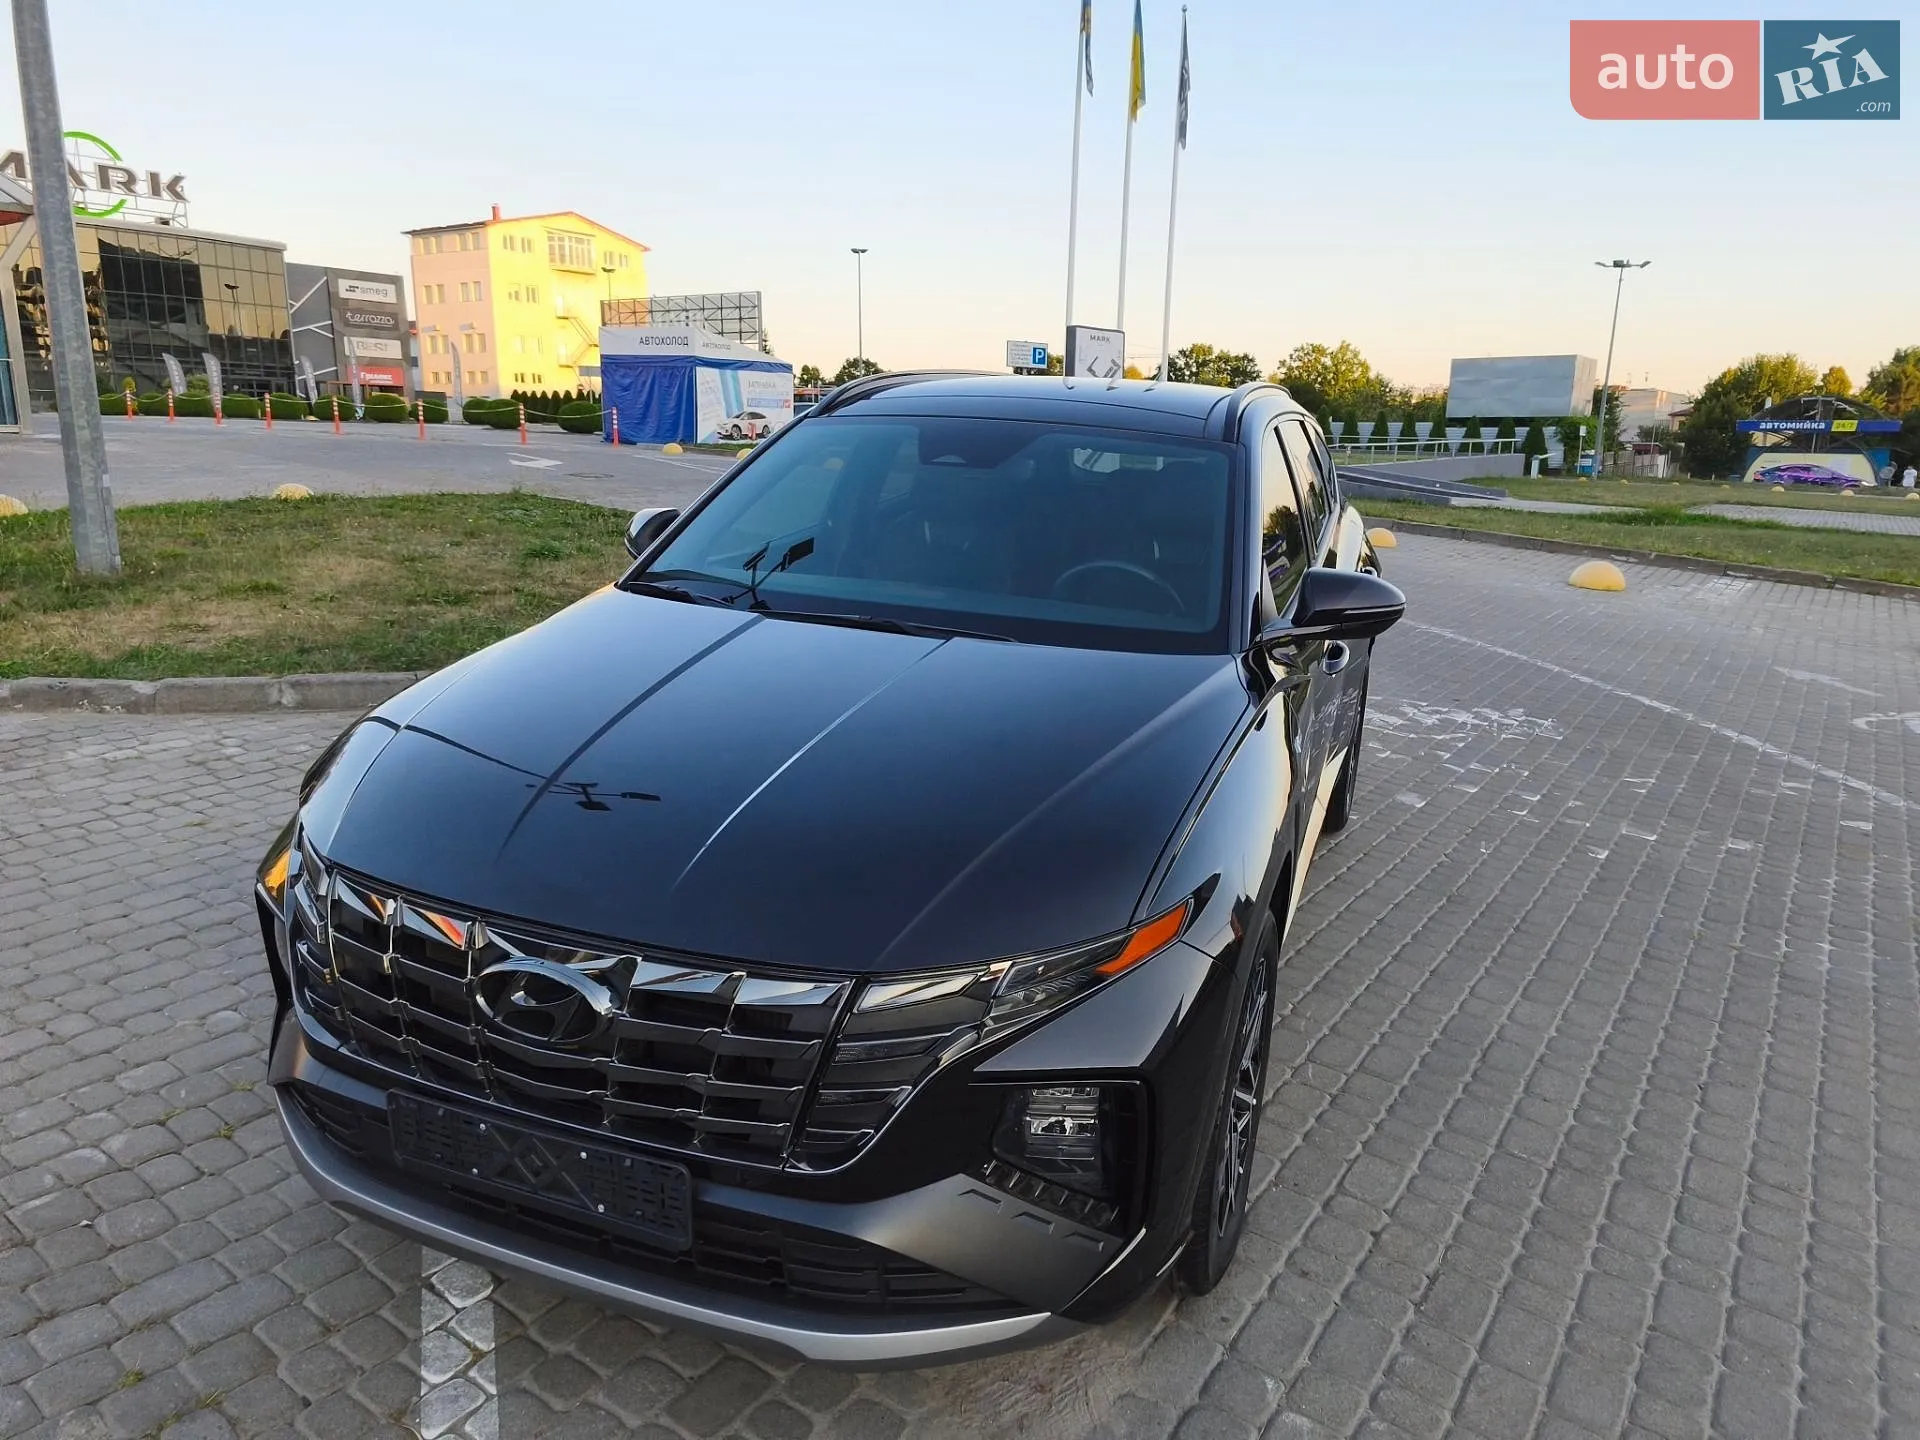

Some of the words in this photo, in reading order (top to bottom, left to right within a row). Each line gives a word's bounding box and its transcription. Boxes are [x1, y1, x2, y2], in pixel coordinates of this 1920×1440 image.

[360, 286, 388, 298] smeg
[639, 335, 689, 347] АВТОХОЛОД
[1035, 349, 1044, 363] P
[1760, 421, 1825, 429] автомийка
